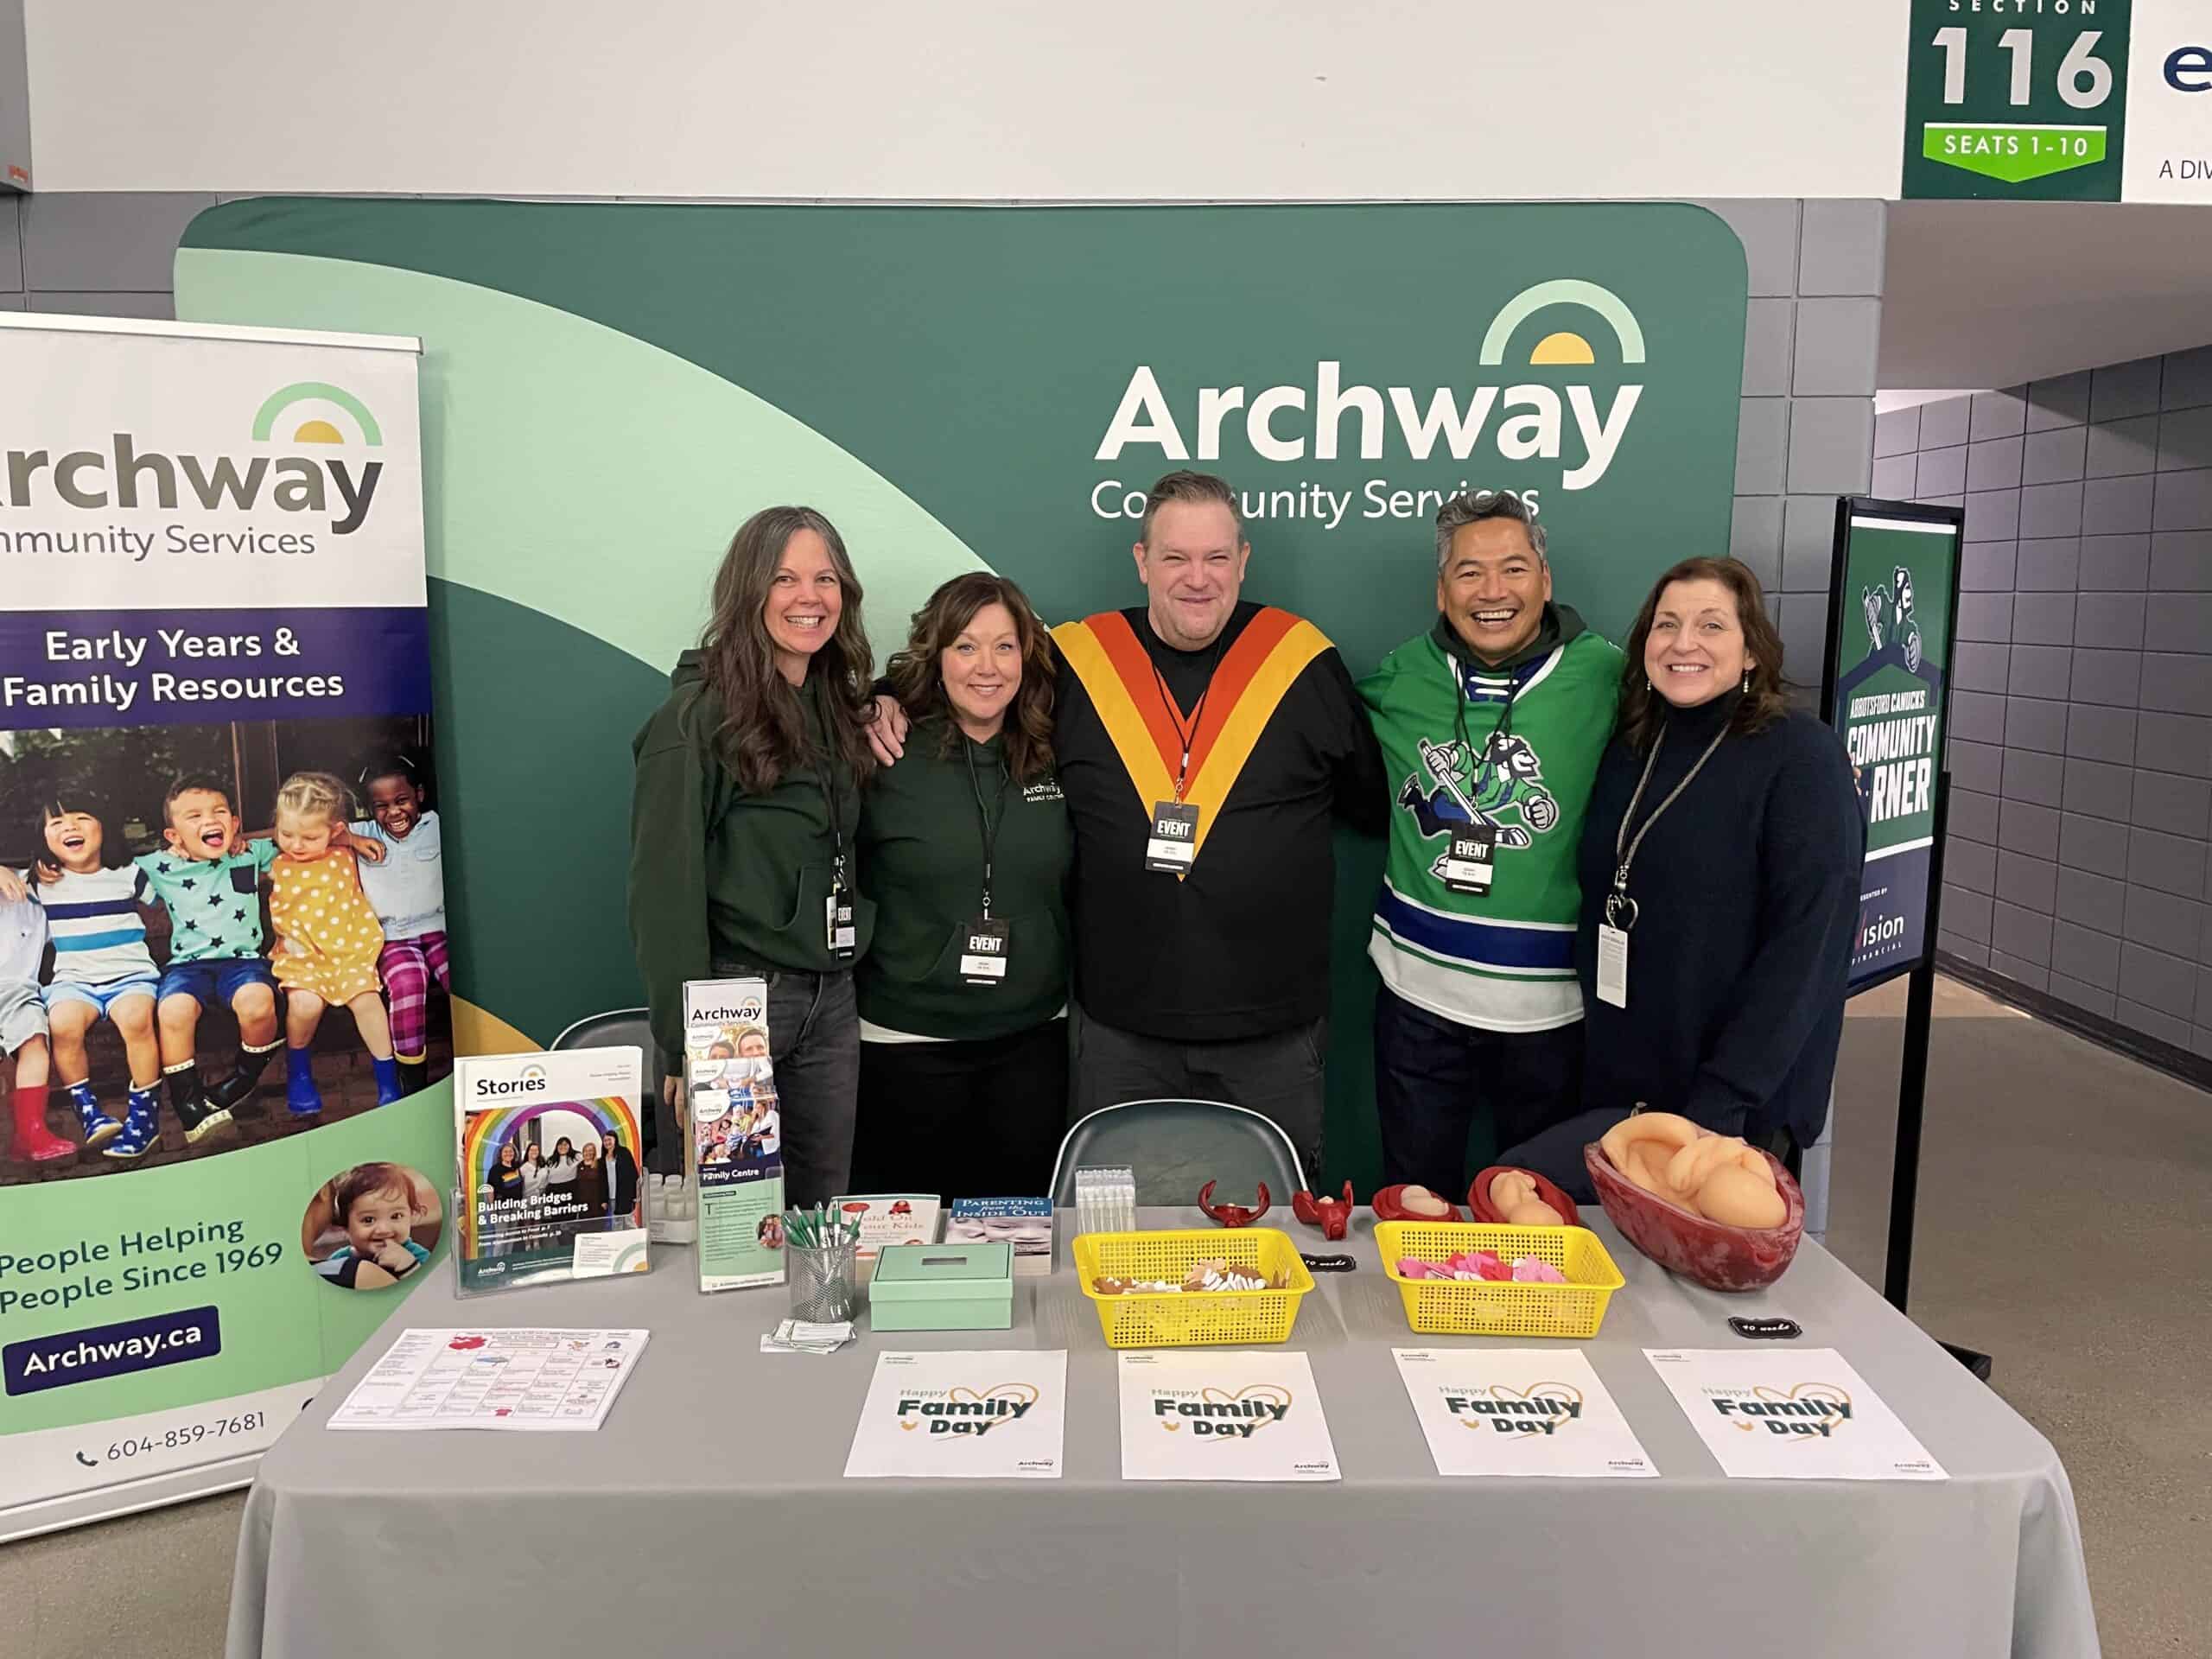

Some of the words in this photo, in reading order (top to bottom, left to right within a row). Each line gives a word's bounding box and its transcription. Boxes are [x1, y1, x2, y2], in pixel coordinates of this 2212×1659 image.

[1948, 0, 2095, 15] SECTION
[1932, 27, 2113, 109] 116
[1944, 135, 2019, 156] SEATS
[2031, 137, 2088, 157] 1-10
[2158, 159, 2173, 179] A
[2181, 159, 2212, 179] DIV
[1094, 361, 1644, 490] Archway
[0, 433, 384, 535] rchway
[1091, 480, 1352, 530] Counity
[1363, 480, 1540, 518] Servs
[167, 524, 316, 555] Services
[46, 630, 148, 667] Early
[157, 628, 262, 658] Years
[274, 626, 301, 657] &
[3, 676, 138, 711] Family
[151, 670, 345, 702] Resources
[1891, 690, 1926, 713] CANUCKS
[1847, 715, 1937, 766] COMMUNITY
[1870, 757, 1932, 823] RNER
[1156, 819, 1192, 837] EVENT
[1454, 839, 1490, 858] EVENT
[969, 935, 1003, 952] EVENT
[691, 1006, 762, 1021] Archway
[476, 1077, 546, 1096] Stories
[702, 1169, 731, 1181] Family
[731, 1168, 760, 1178] Centre
[477, 1195, 528, 1213] Building
[530, 1191, 573, 1207] Bridges
[477, 1215, 487, 1225] &
[490, 1208, 542, 1225] Breaking
[543, 1202, 588, 1217] Barriers
[0, 1240, 111, 1279] People
[120, 1218, 245, 1258] Helping
[0, 1274, 113, 1314] People
[123, 1262, 208, 1293] Since
[215, 1242, 283, 1274] 1969
[22, 1325, 202, 1377] Archway.ca
[899, 1389, 948, 1399] Happy
[1150, 1388, 1199, 1398] Happy
[1438, 1386, 1487, 1396] Happy
[1701, 1387, 1751, 1397] Happy
[896, 1398, 1033, 1419] Family
[1154, 1398, 1290, 1421] Family
[1445, 1396, 1581, 1419] Family
[1711, 1397, 1853, 1419] Family
[106, 1411, 265, 1462] 604-859-7681
[929, 1419, 994, 1436] Day
[1192, 1420, 1256, 1438] Day
[1491, 1418, 1555, 1435] Day
[1763, 1420, 1833, 1438] Day
